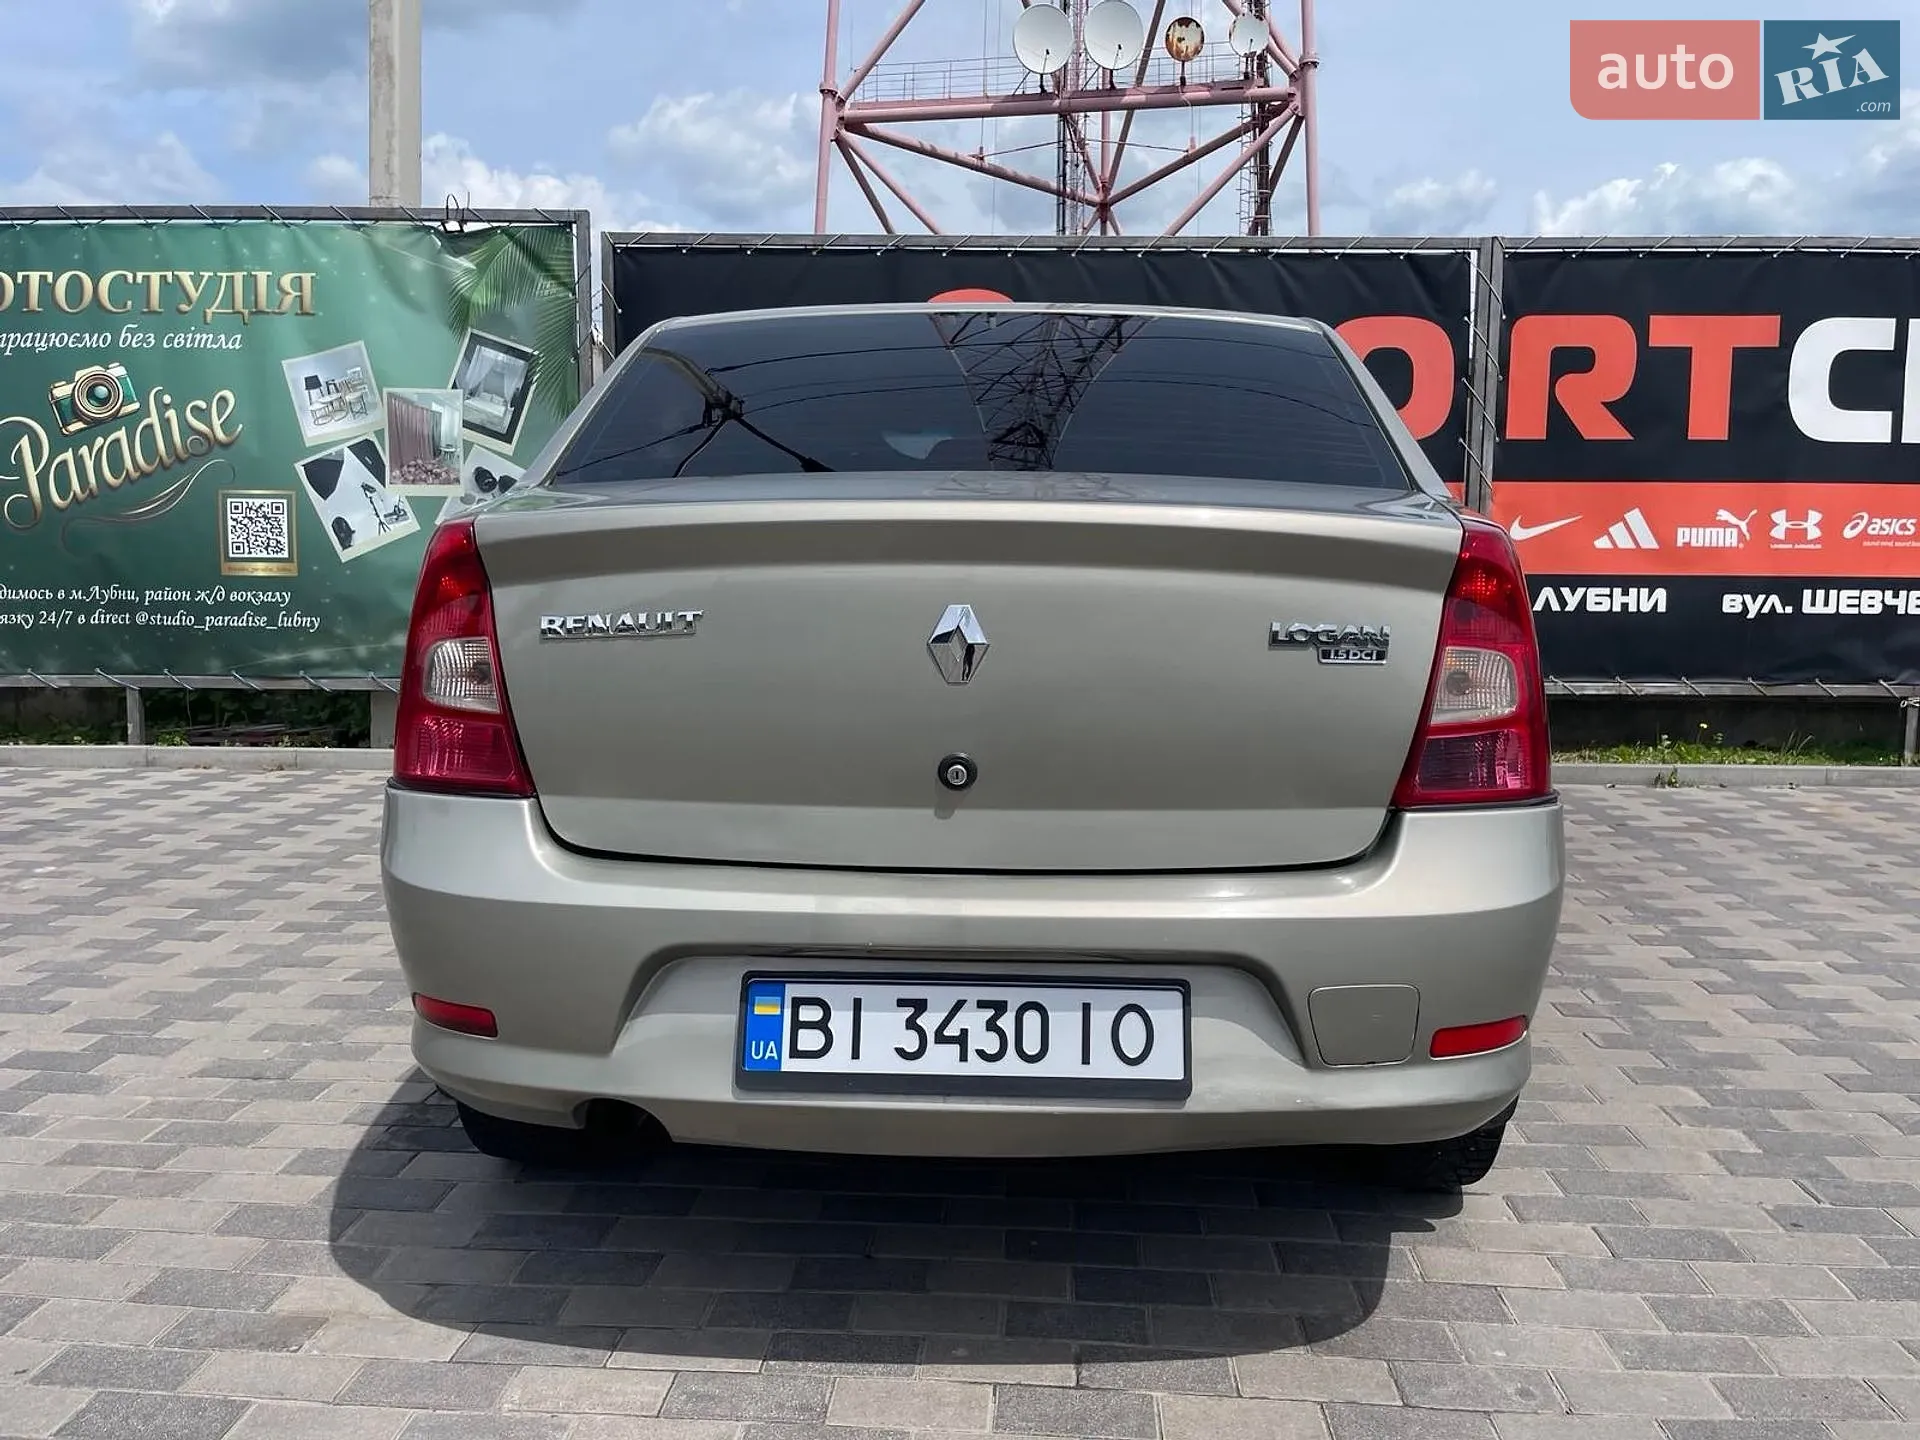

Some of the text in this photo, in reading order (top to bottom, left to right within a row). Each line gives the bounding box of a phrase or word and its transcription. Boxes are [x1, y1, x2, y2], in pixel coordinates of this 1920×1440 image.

[119, 323, 155, 349] без
[163, 326, 243, 350] світла
[0, 386, 243, 529] Paradise
[1676, 527, 1738, 547] PUMA
[57, 588, 65, 600] в
[144, 587, 191, 605] район
[195, 585, 226, 605] ж/д
[229, 590, 291, 607] вокзалу
[1532, 586, 1667, 614] ЛУБНИ
[1722, 594, 1792, 619] вул.
[39, 609, 73, 628] 24/7
[77, 614, 86, 624] в
[90, 608, 130, 625] direct
[136, 609, 320, 632] @studio_paradise_lubny
[540, 609, 704, 638] RENAULT
[1269, 621, 1391, 648] LOGAN
[789, 996, 1154, 1067] BI 3430 IO
[751, 1040, 778, 1061] UA
